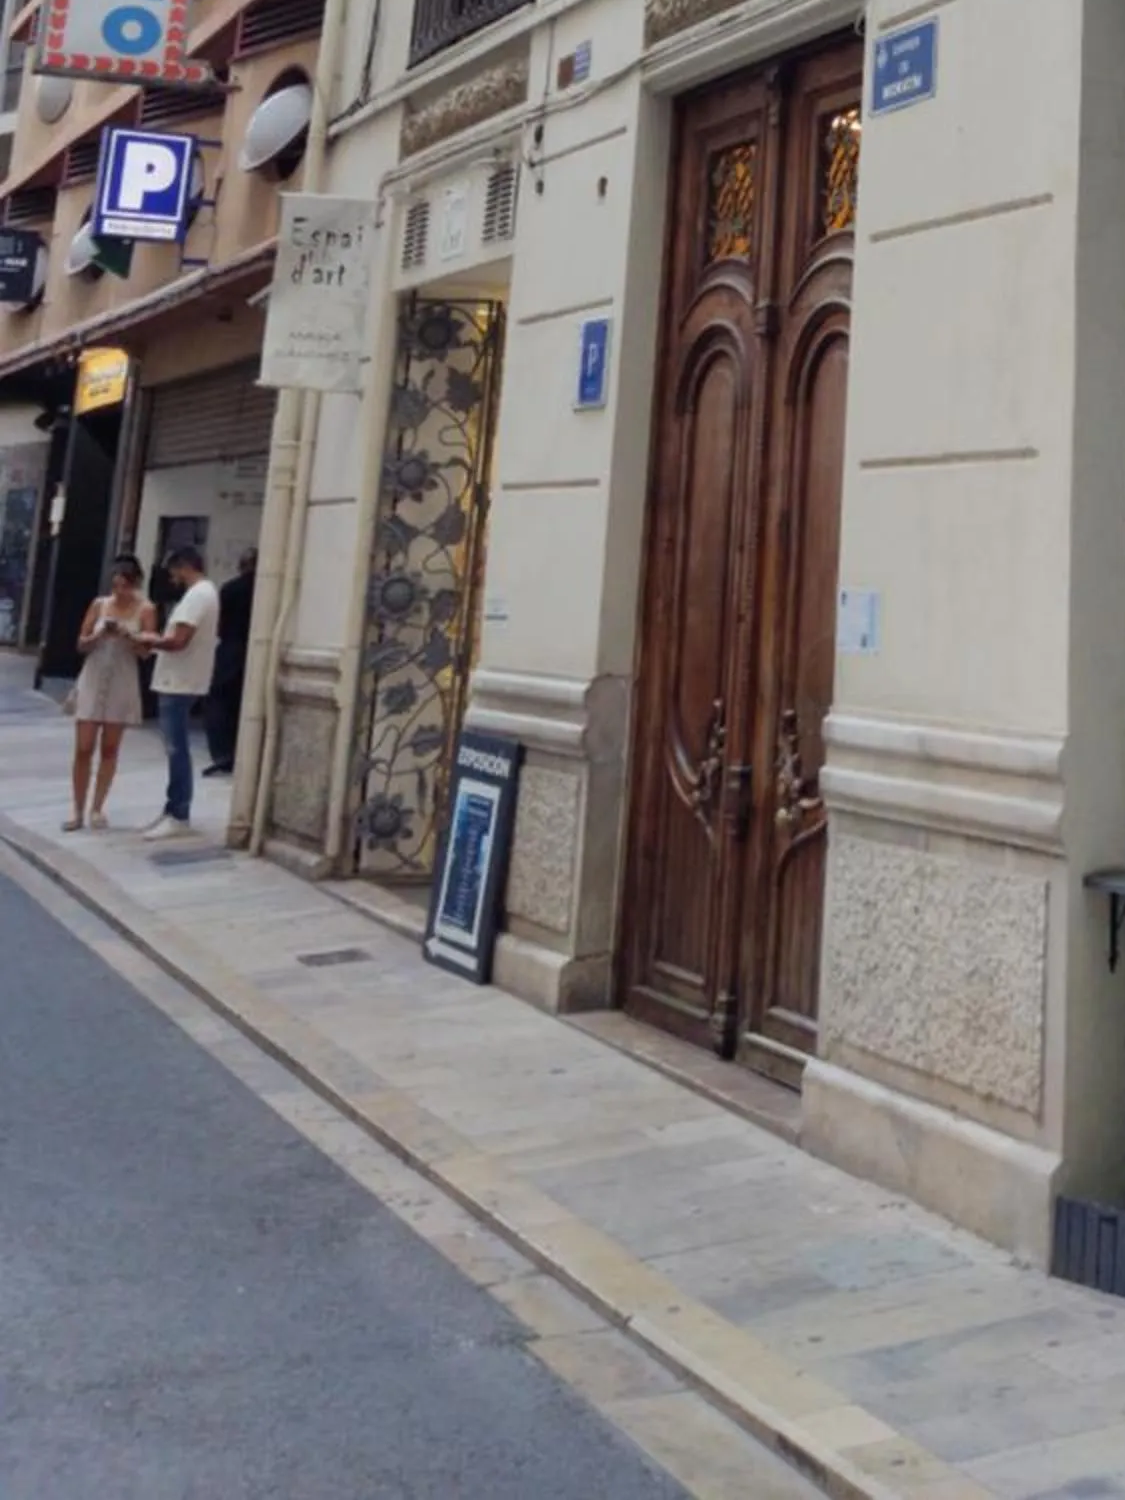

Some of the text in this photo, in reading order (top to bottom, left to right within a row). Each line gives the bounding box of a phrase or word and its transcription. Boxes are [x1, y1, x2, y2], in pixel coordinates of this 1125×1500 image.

[118, 141, 177, 210] P
[291, 215, 365, 248] Espai
[586, 342, 599, 377] P
